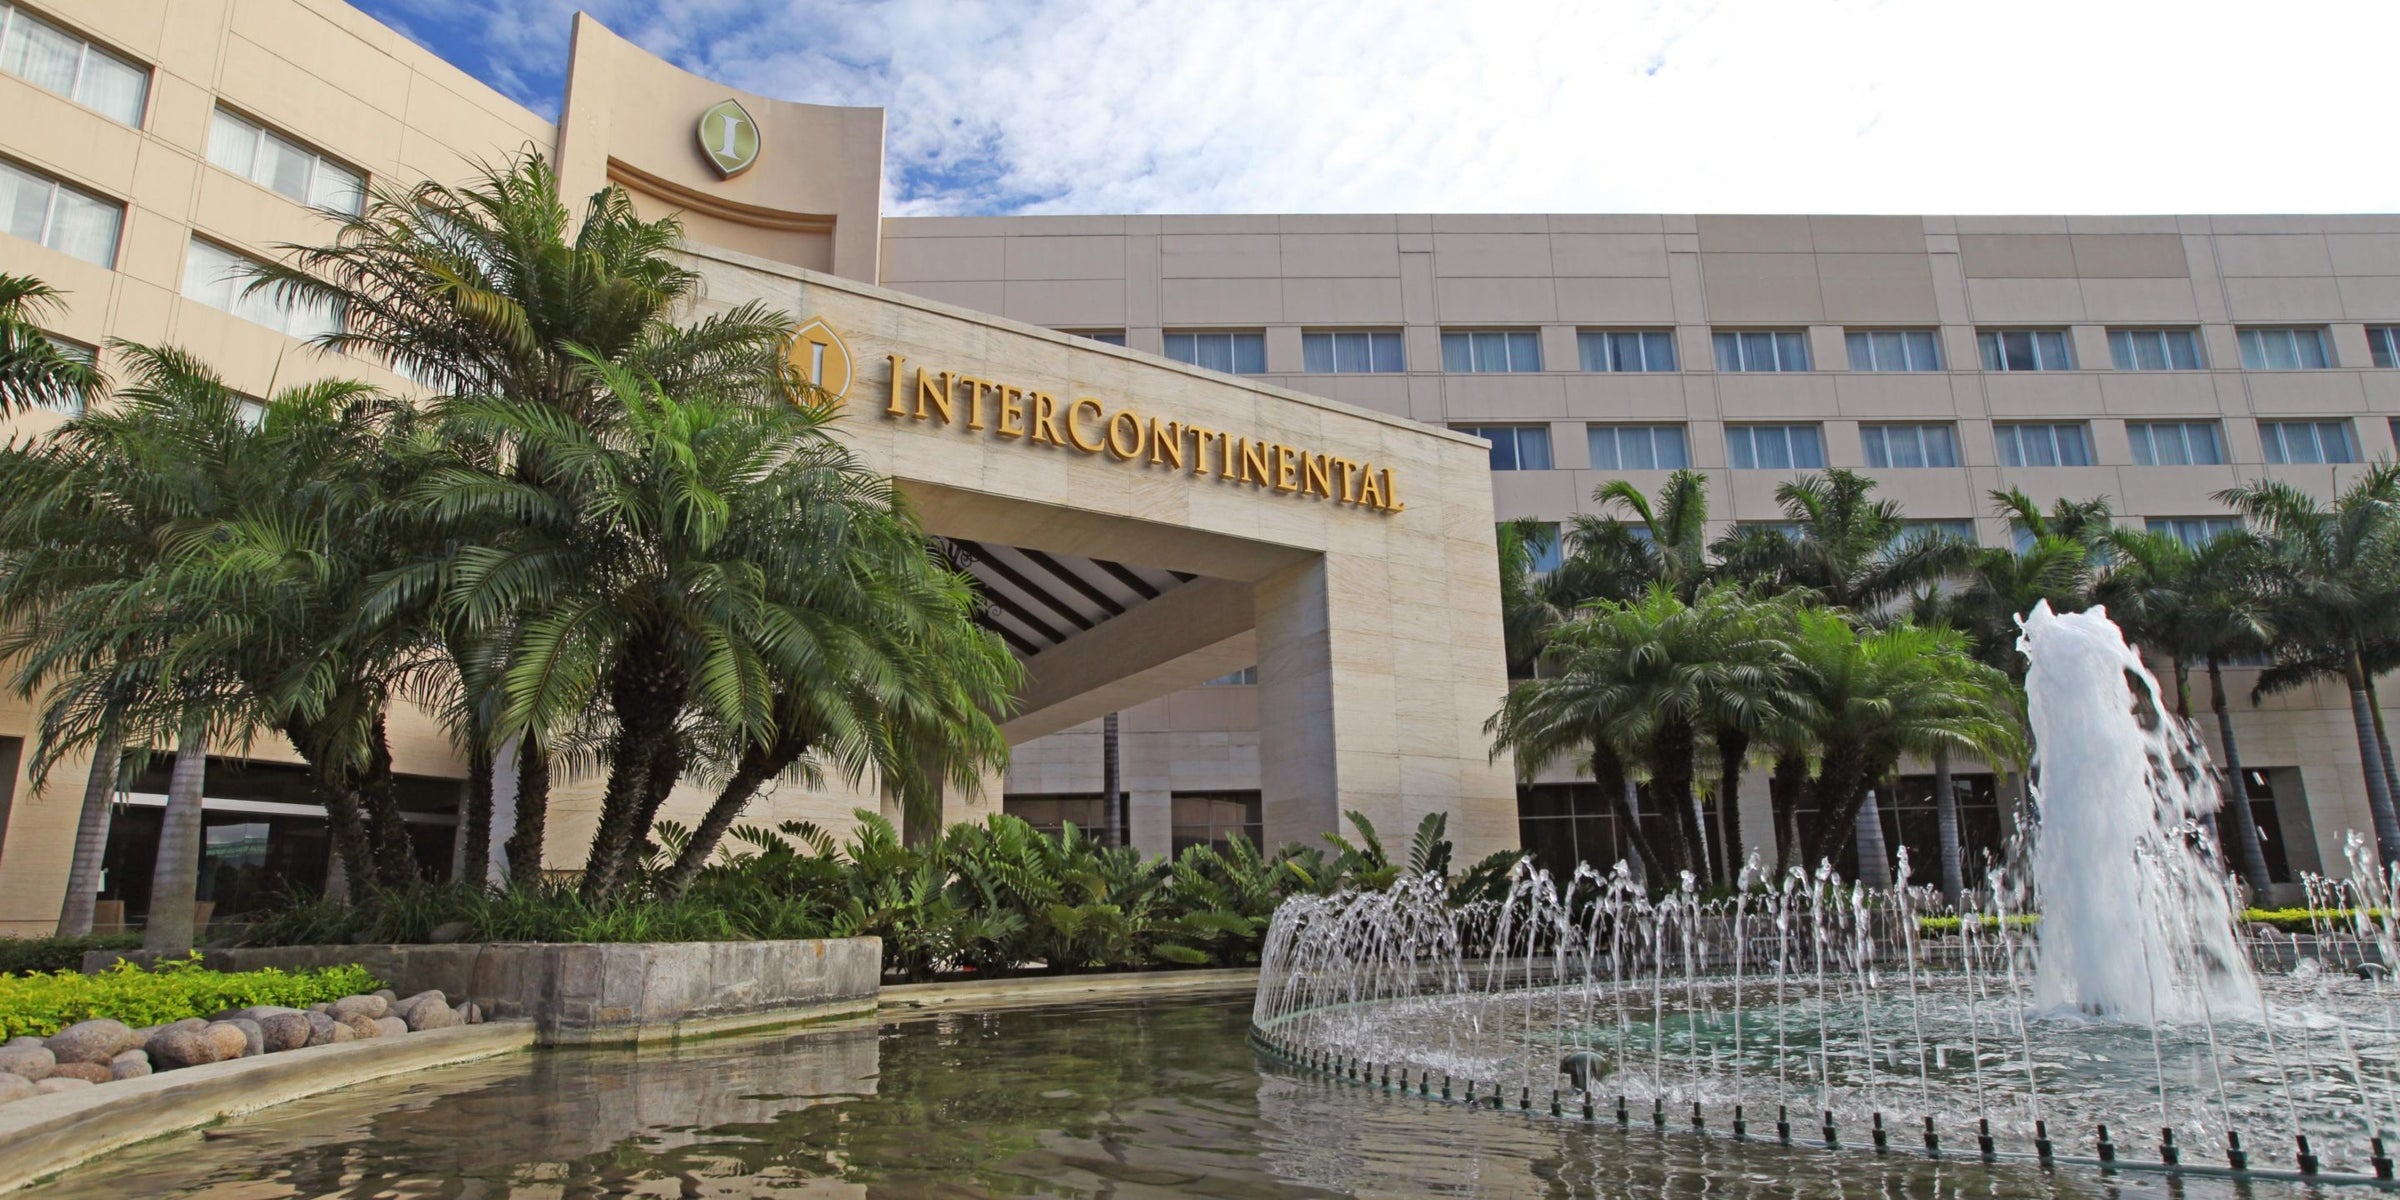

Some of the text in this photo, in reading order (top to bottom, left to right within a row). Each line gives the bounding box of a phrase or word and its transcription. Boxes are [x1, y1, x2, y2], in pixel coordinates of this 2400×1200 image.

[715, 113, 745, 161] I
[809, 340, 828, 390] I
[885, 353, 1406, 513] INTERCONTINENTAL
